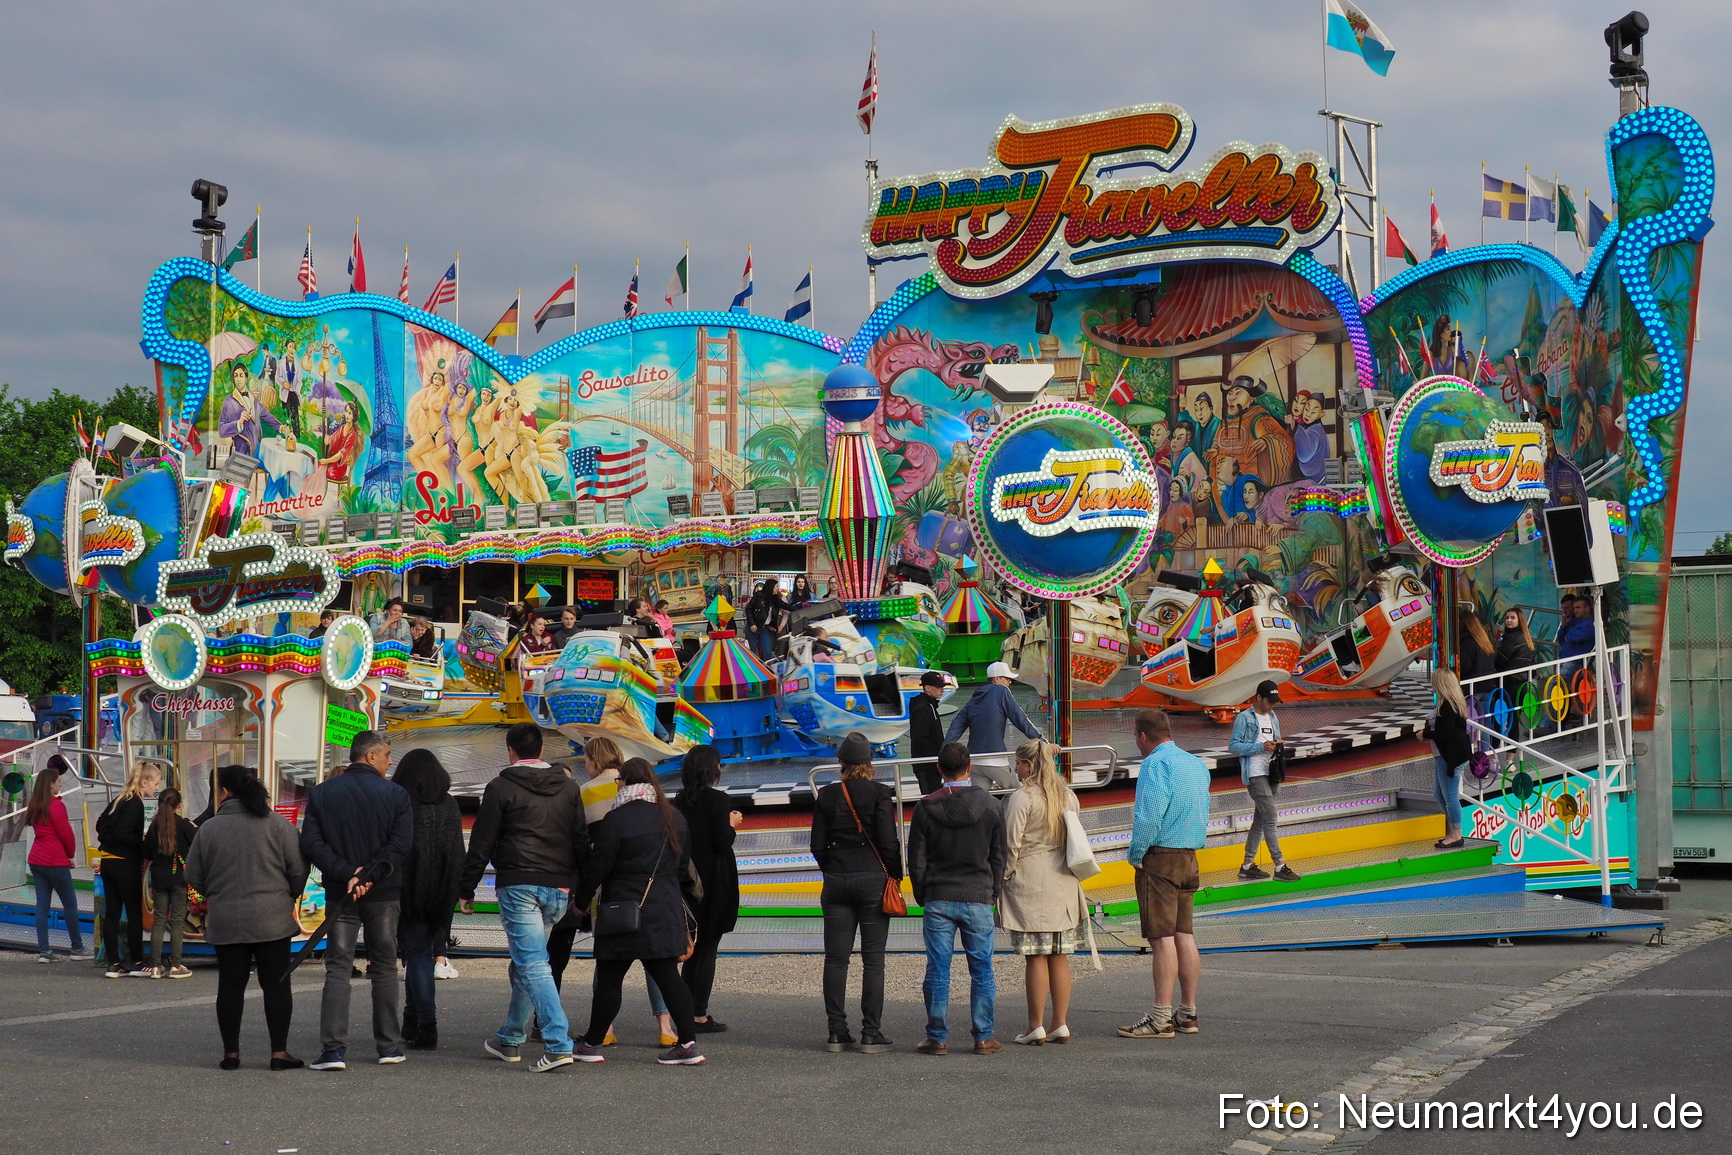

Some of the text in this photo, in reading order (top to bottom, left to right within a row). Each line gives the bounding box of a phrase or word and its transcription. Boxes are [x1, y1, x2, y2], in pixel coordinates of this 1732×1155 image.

[869, 112, 1328, 285] HAPPY Traveller
[578, 368, 669, 399] Sausalito
[828, 388, 858, 399] PARIS
[1441, 447, 1511, 484] HAPPY
[243, 492, 324, 519] ntmartre
[1001, 458, 1154, 525] HAPPY Traveller
[191, 545, 328, 615] Traveller
[151, 693, 235, 719] Chipkasse
[328, 707, 342, 718] Freitag
[1469, 804, 1507, 839] Paris
[1510, 795, 1558, 858] Moska
